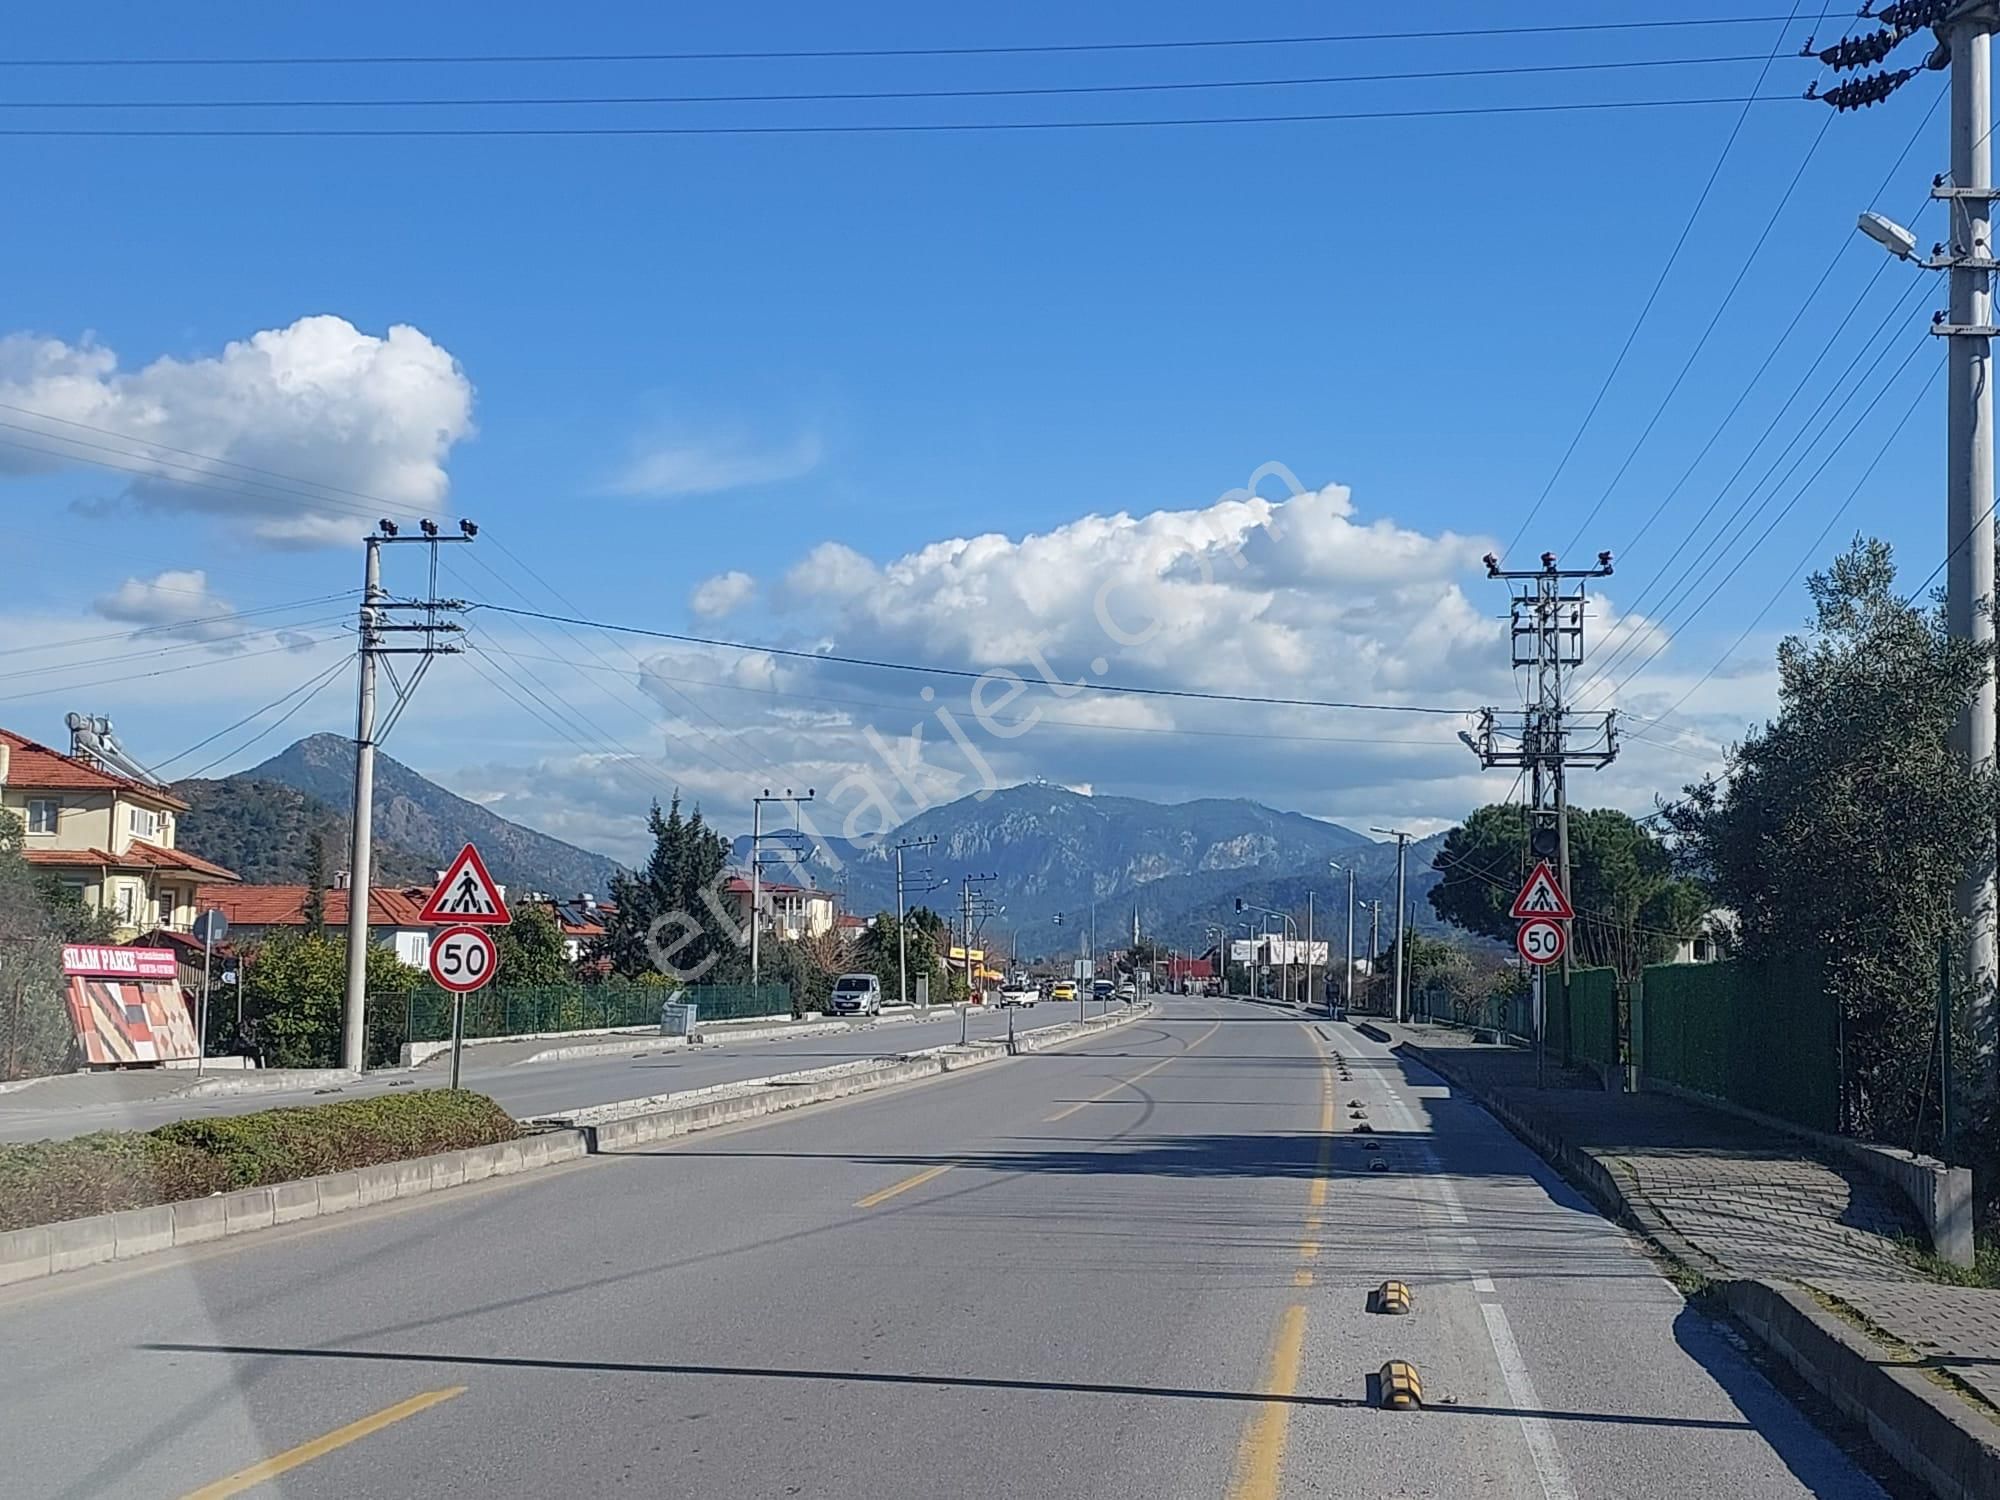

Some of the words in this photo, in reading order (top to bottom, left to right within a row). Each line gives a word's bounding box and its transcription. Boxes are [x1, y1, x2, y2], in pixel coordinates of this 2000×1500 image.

[1528, 931, 1557, 953] 50
[100, 949, 137, 972] PARKE
[443, 944, 485, 976] 50
